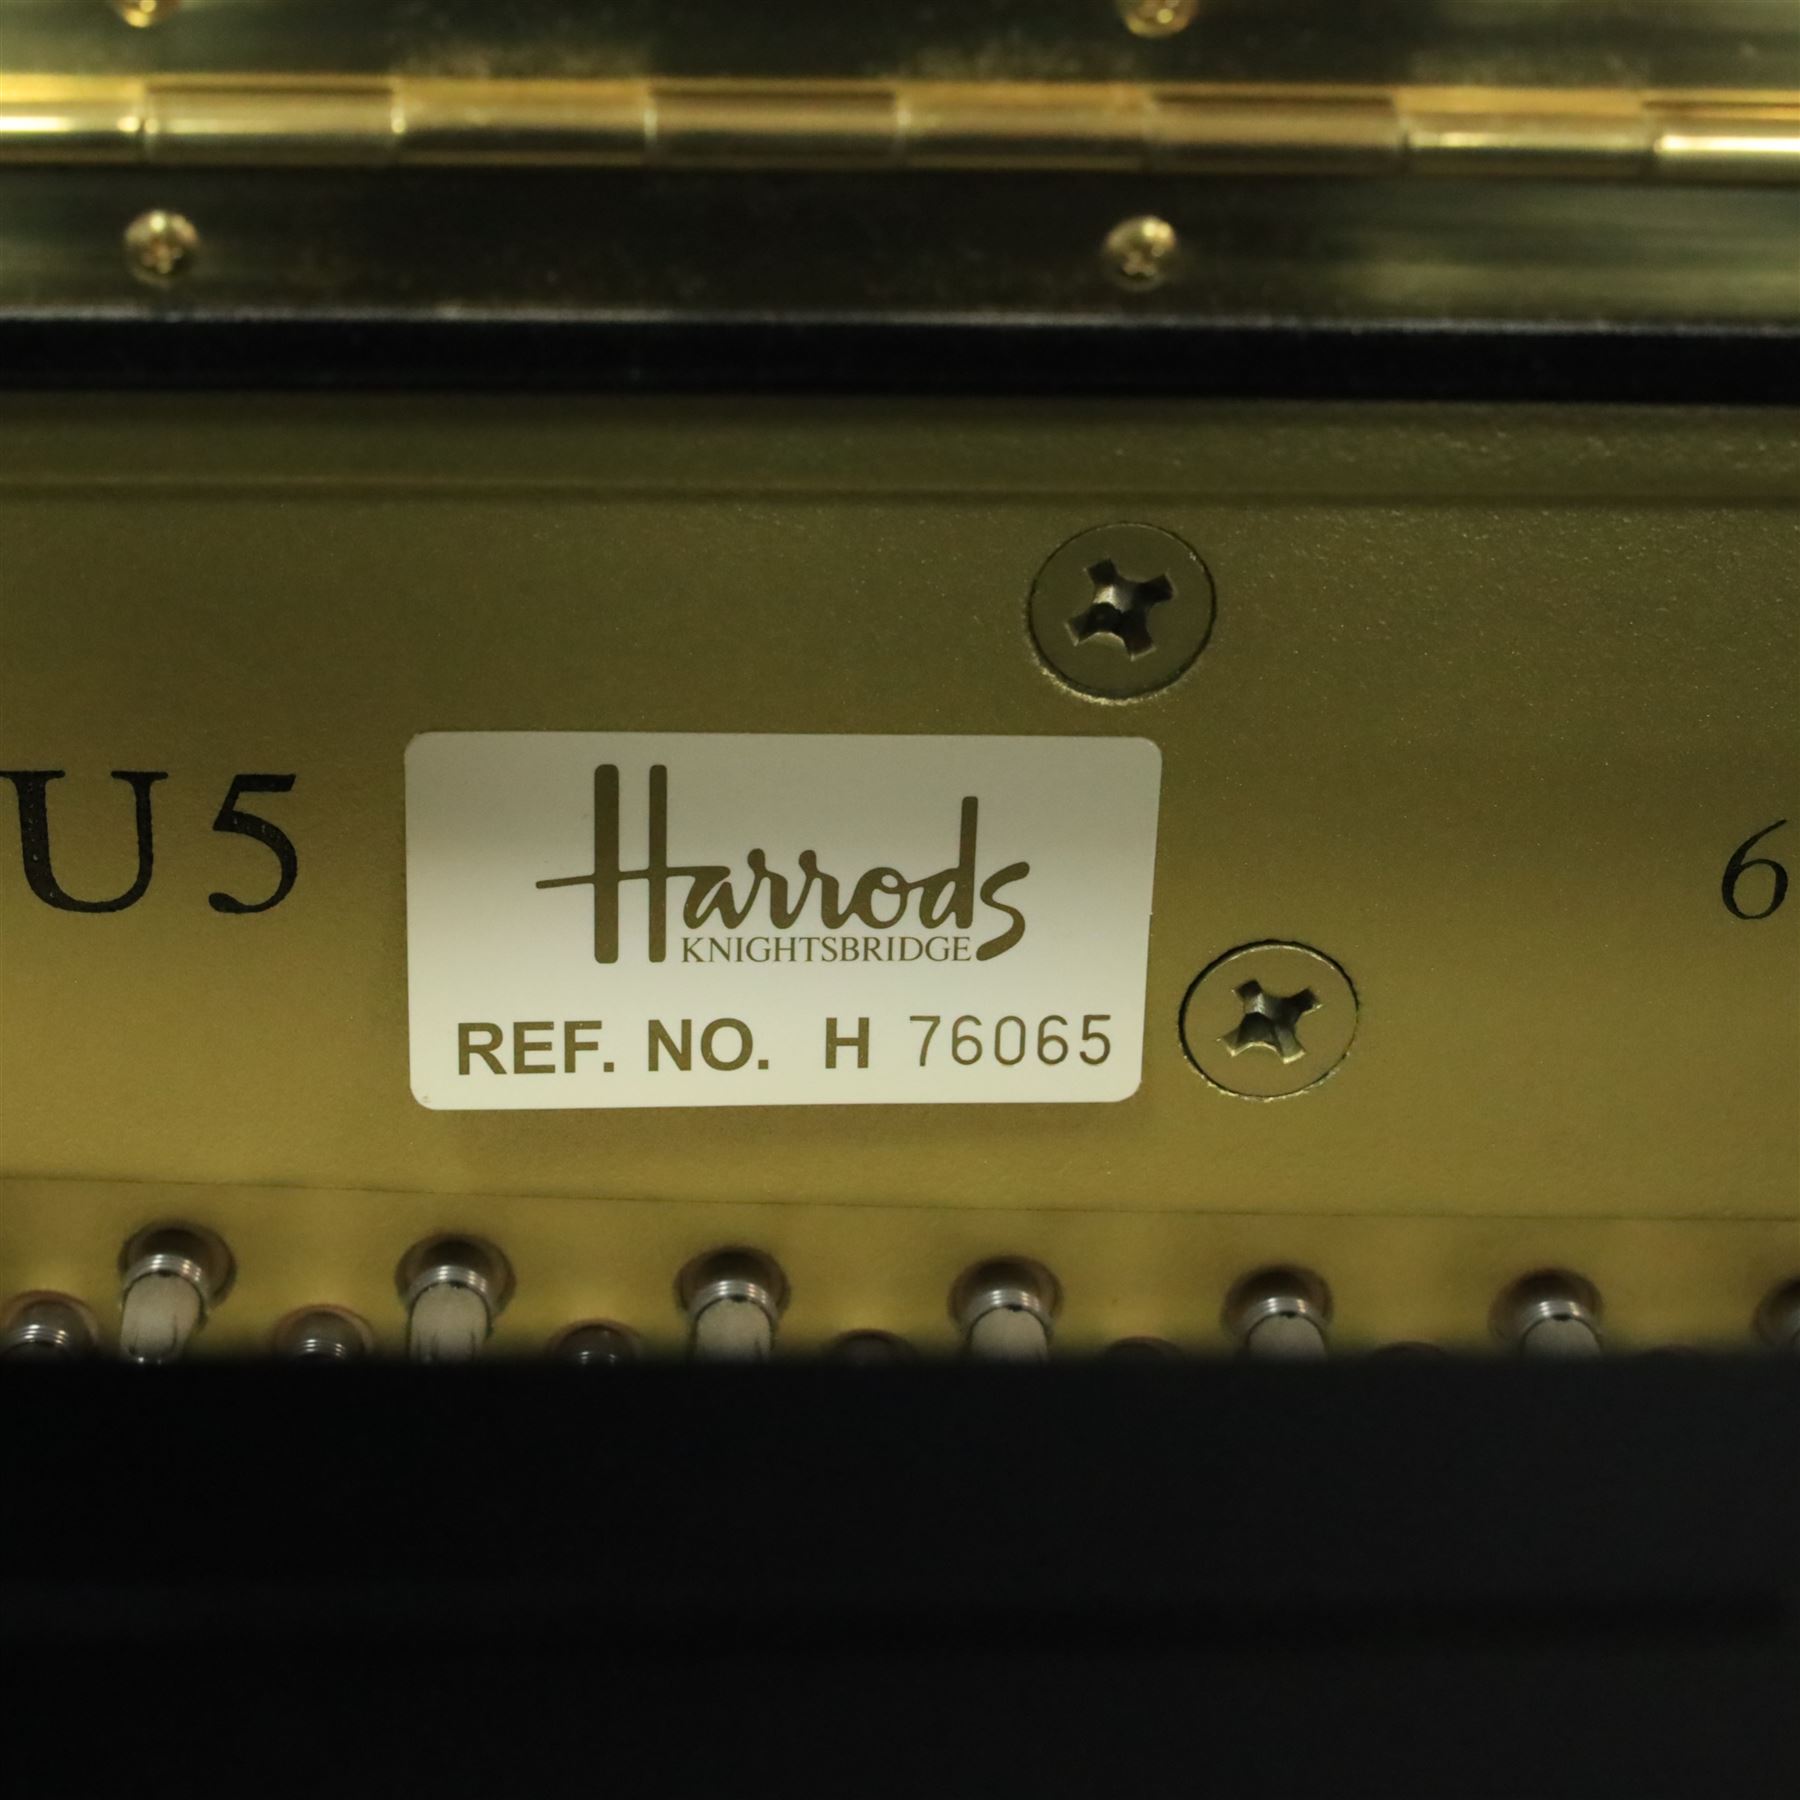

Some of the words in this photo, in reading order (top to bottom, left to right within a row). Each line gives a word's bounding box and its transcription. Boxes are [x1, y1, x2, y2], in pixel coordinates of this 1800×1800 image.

[535, 763, 1031, 965] Harrods
[1721, 818, 1789, 921] 6
[681, 936, 973, 964] KNIGHTSBRIDGE
[457, 1019, 616, 1075] REF.
[648, 1017, 770, 1073] NO.
[824, 1016, 872, 1070] H
[910, 1013, 1113, 1067] 76065
